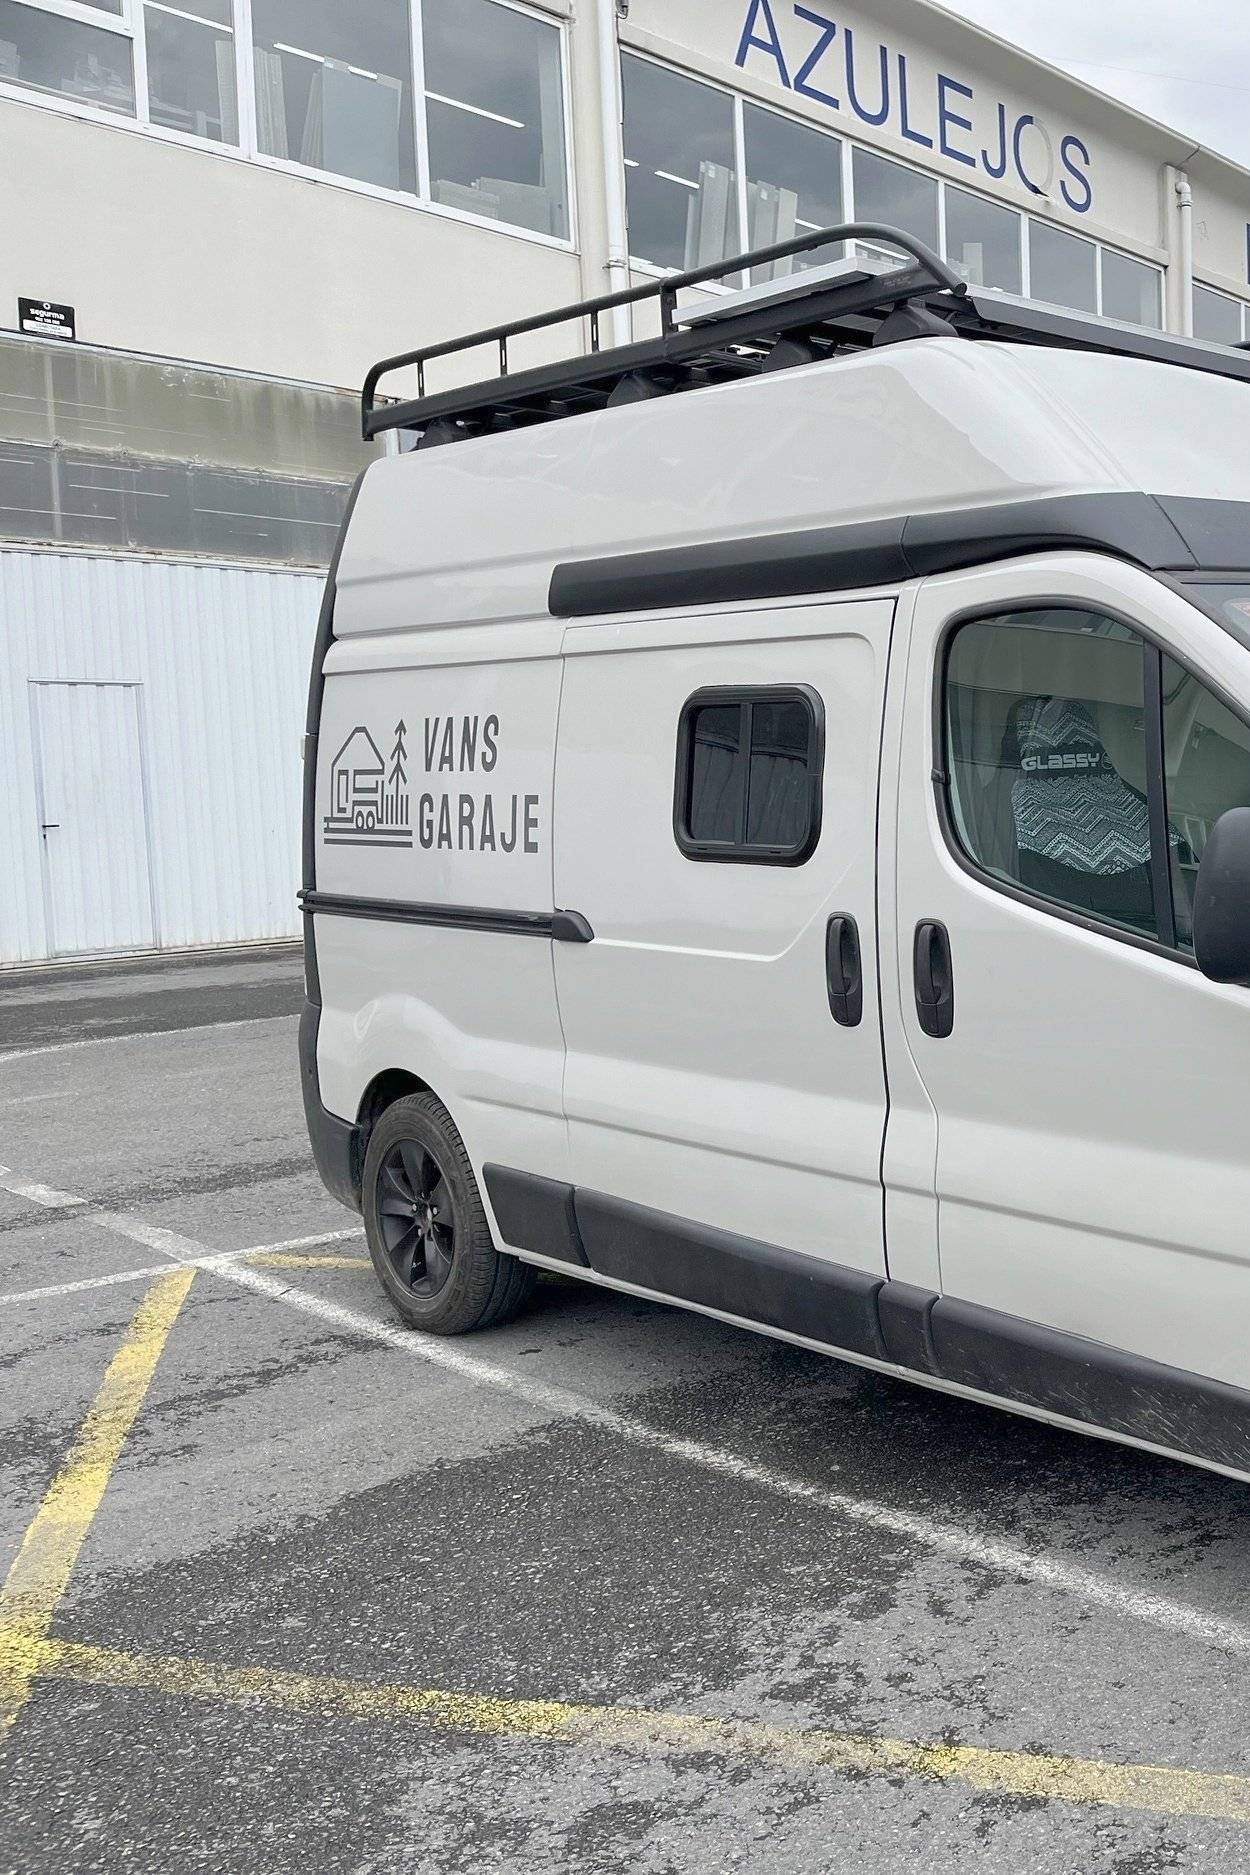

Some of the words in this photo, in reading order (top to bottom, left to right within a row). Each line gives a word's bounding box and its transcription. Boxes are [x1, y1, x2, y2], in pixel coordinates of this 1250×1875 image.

[735, 0, 1092, 213] AZULEJOS
[424, 714, 499, 772] VANS
[419, 793, 539, 853] GARAJE
